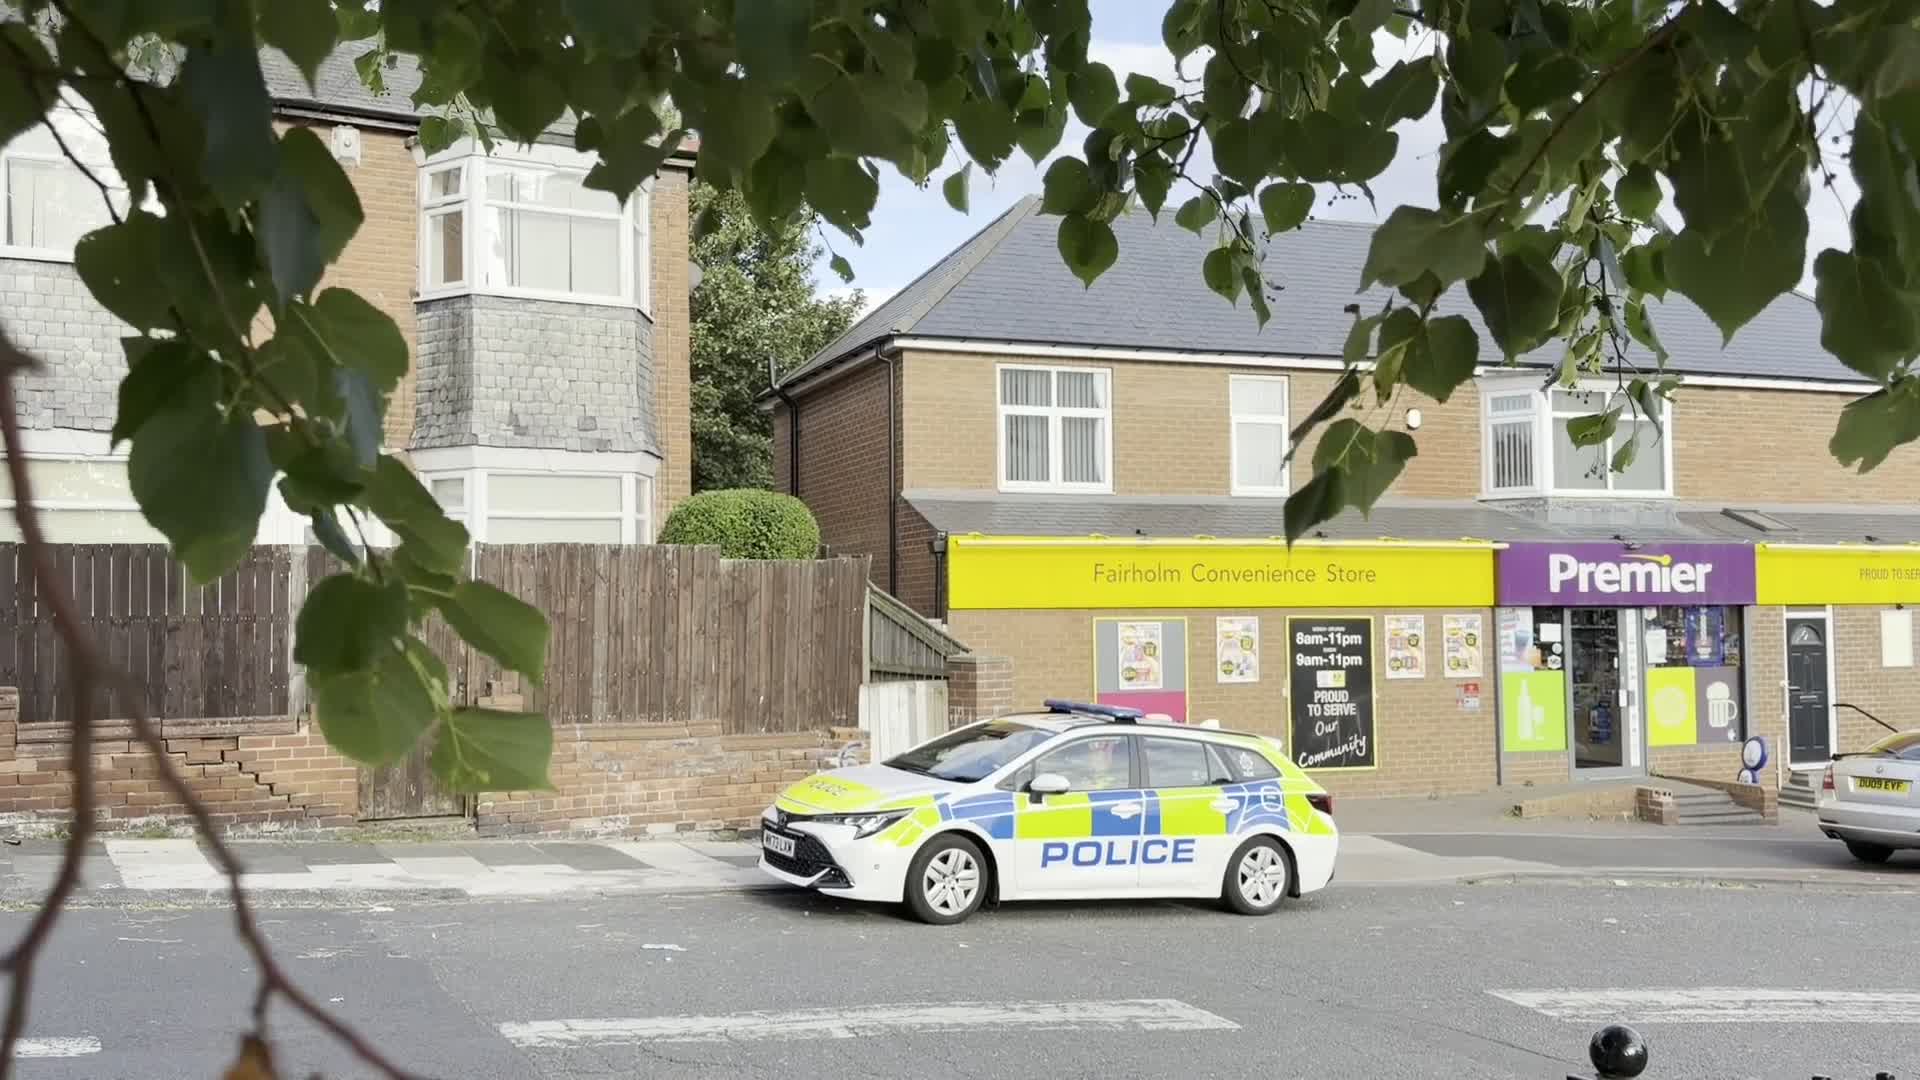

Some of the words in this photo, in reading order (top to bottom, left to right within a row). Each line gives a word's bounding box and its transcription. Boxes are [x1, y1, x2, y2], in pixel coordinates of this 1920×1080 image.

[1093, 562, 1181, 583] Fairholm
[1191, 562, 1316, 583] Convenience
[1326, 562, 1377, 583] Store
[1549, 553, 1713, 593] Premier
[1859, 567, 1889, 581] PROUD
[1891, 567, 1903, 580] TO
[1295, 631, 1362, 648] 8am-11pm
[1295, 652, 1363, 669] 9am-11pm
[1313, 690, 1349, 704] PROUD
[1307, 703, 1322, 717] TO
[1323, 702, 1357, 717] SERVE
[1314, 720, 1338, 737] Our
[1298, 733, 1367, 768] Community
[1040, 838, 1196, 868] POLICE
